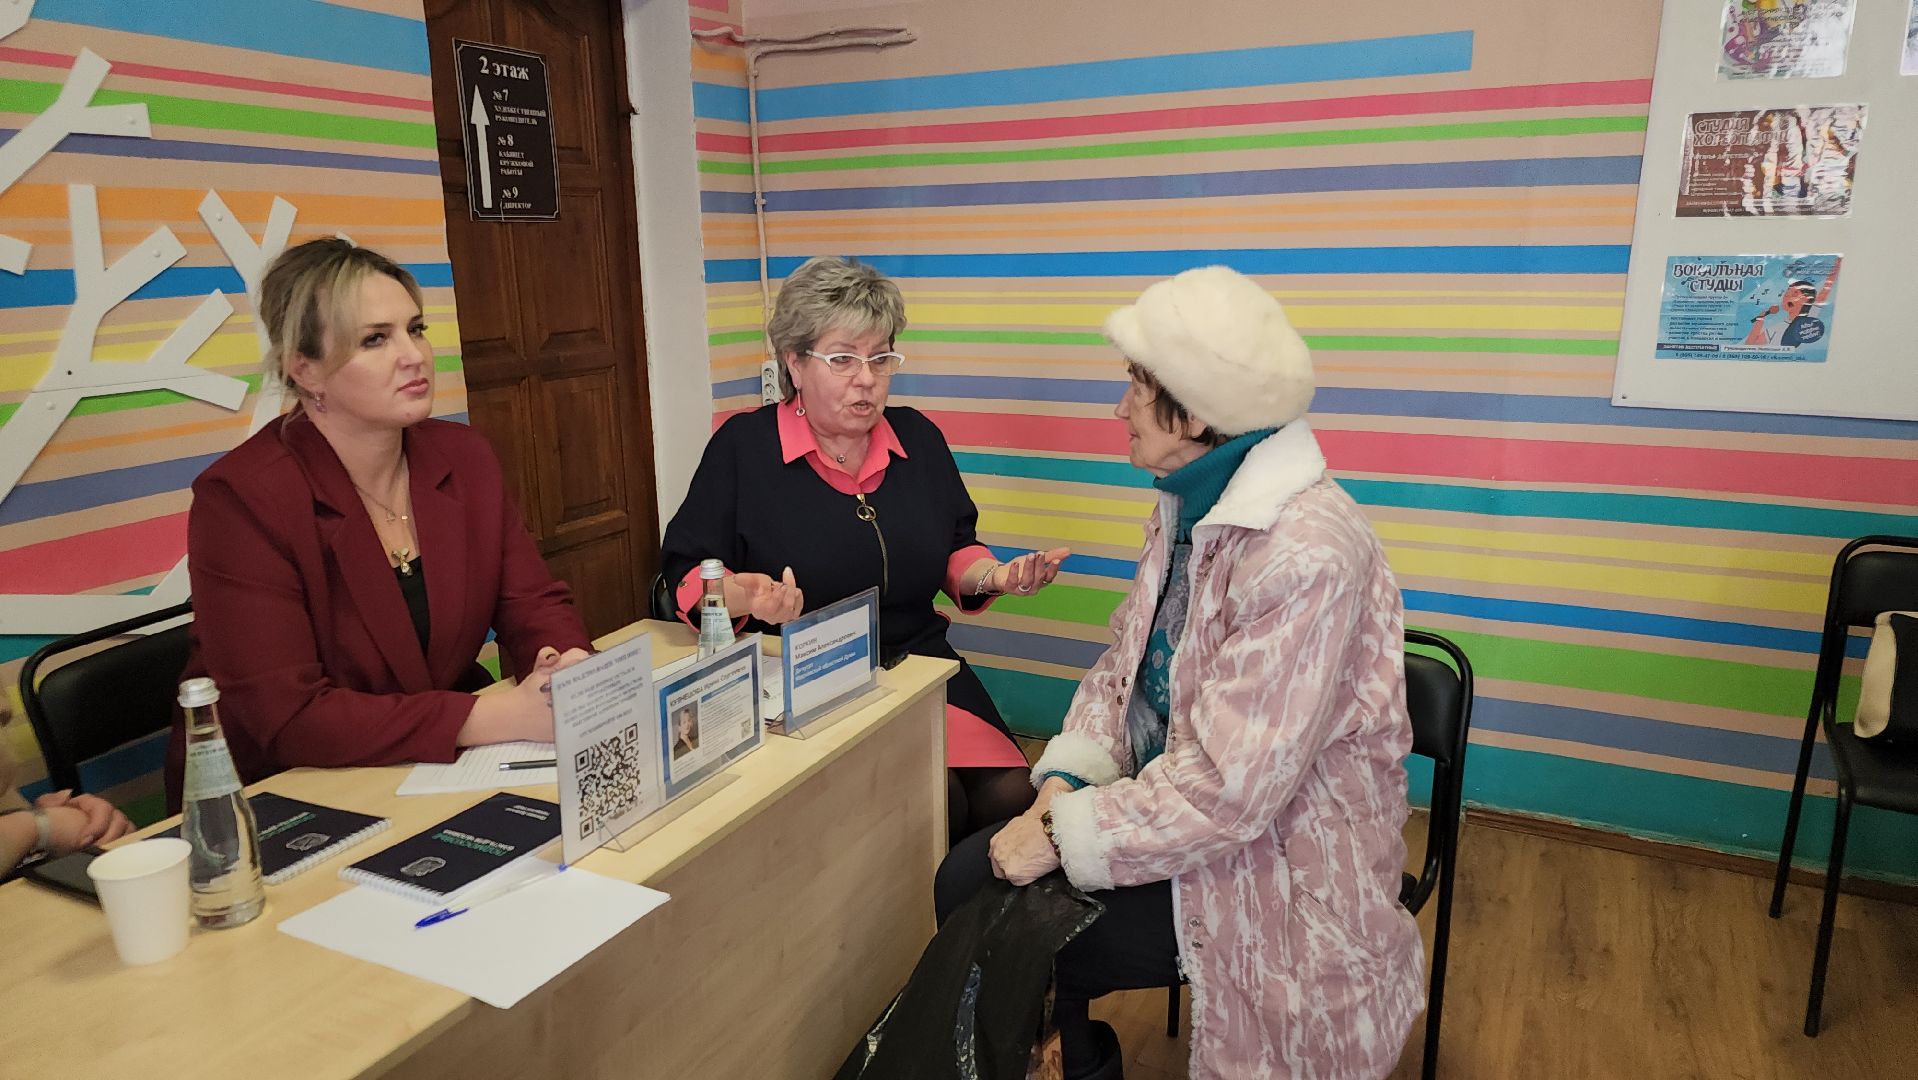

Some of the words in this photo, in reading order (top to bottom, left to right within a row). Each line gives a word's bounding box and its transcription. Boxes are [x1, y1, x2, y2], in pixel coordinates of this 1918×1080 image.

[479, 56, 489, 74] 2
[492, 62, 529, 80] этаж
[1673, 264, 1764, 278] ВОКАЛЬНАЯ
[1689, 279, 1743, 293] СТУДИЯ
